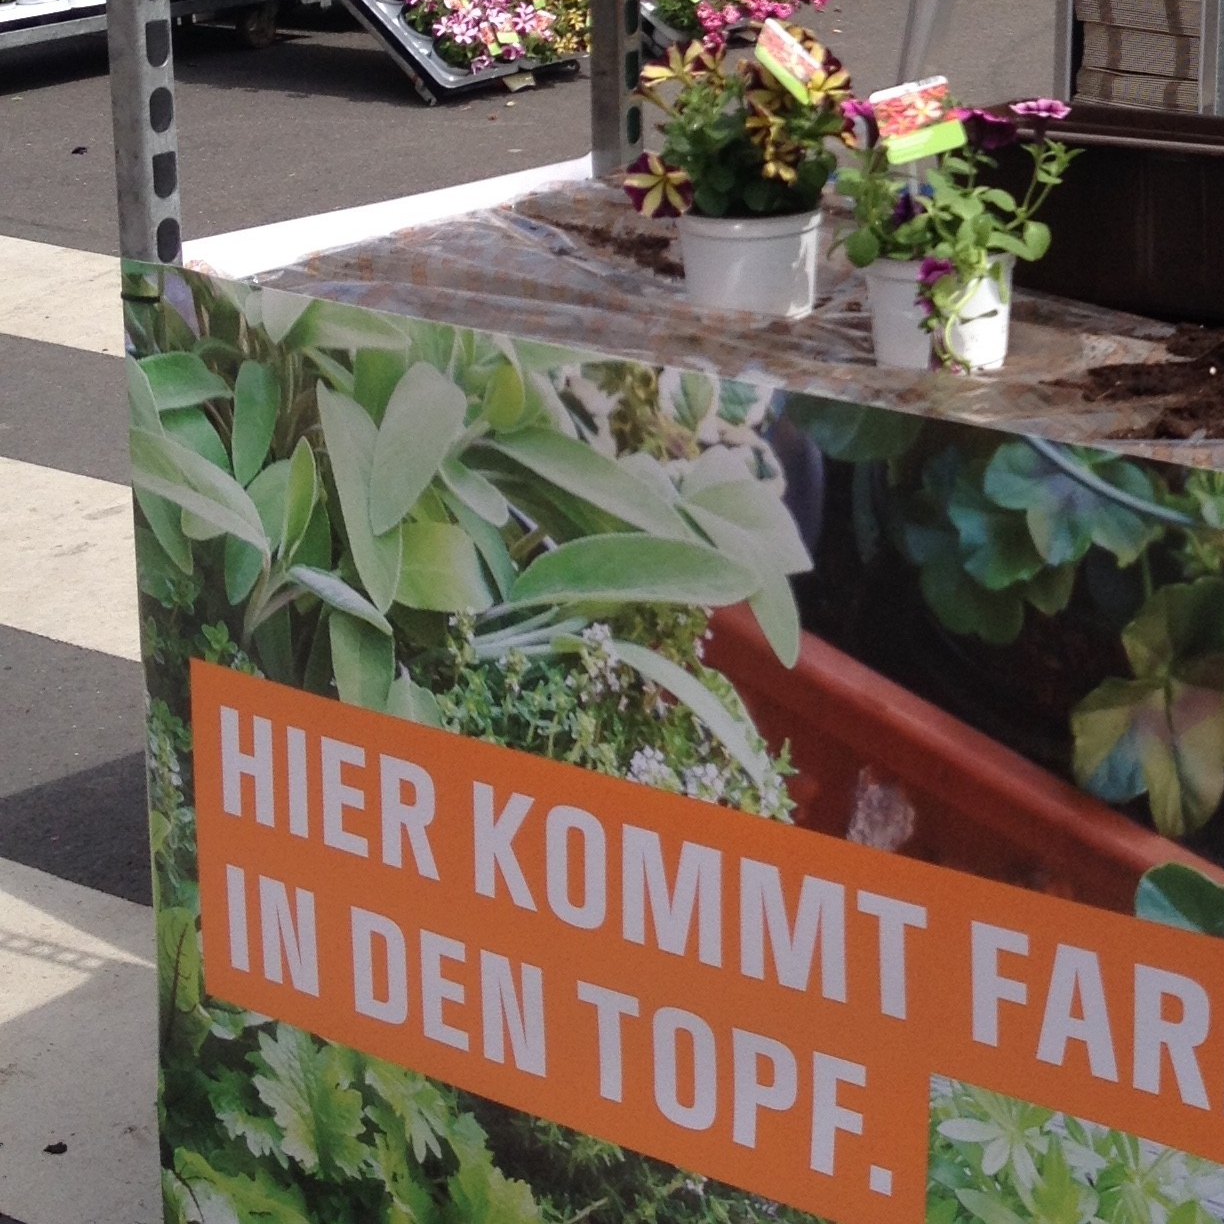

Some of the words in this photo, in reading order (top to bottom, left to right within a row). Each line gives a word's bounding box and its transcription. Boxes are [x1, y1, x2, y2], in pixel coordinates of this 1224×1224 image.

[220, 705, 440, 881] HIER
[473, 780, 927, 1020] KOMMT
[226, 864, 320, 998] IN
[351, 906, 546, 1076] DEN
[577, 980, 892, 1197] TOPF.
